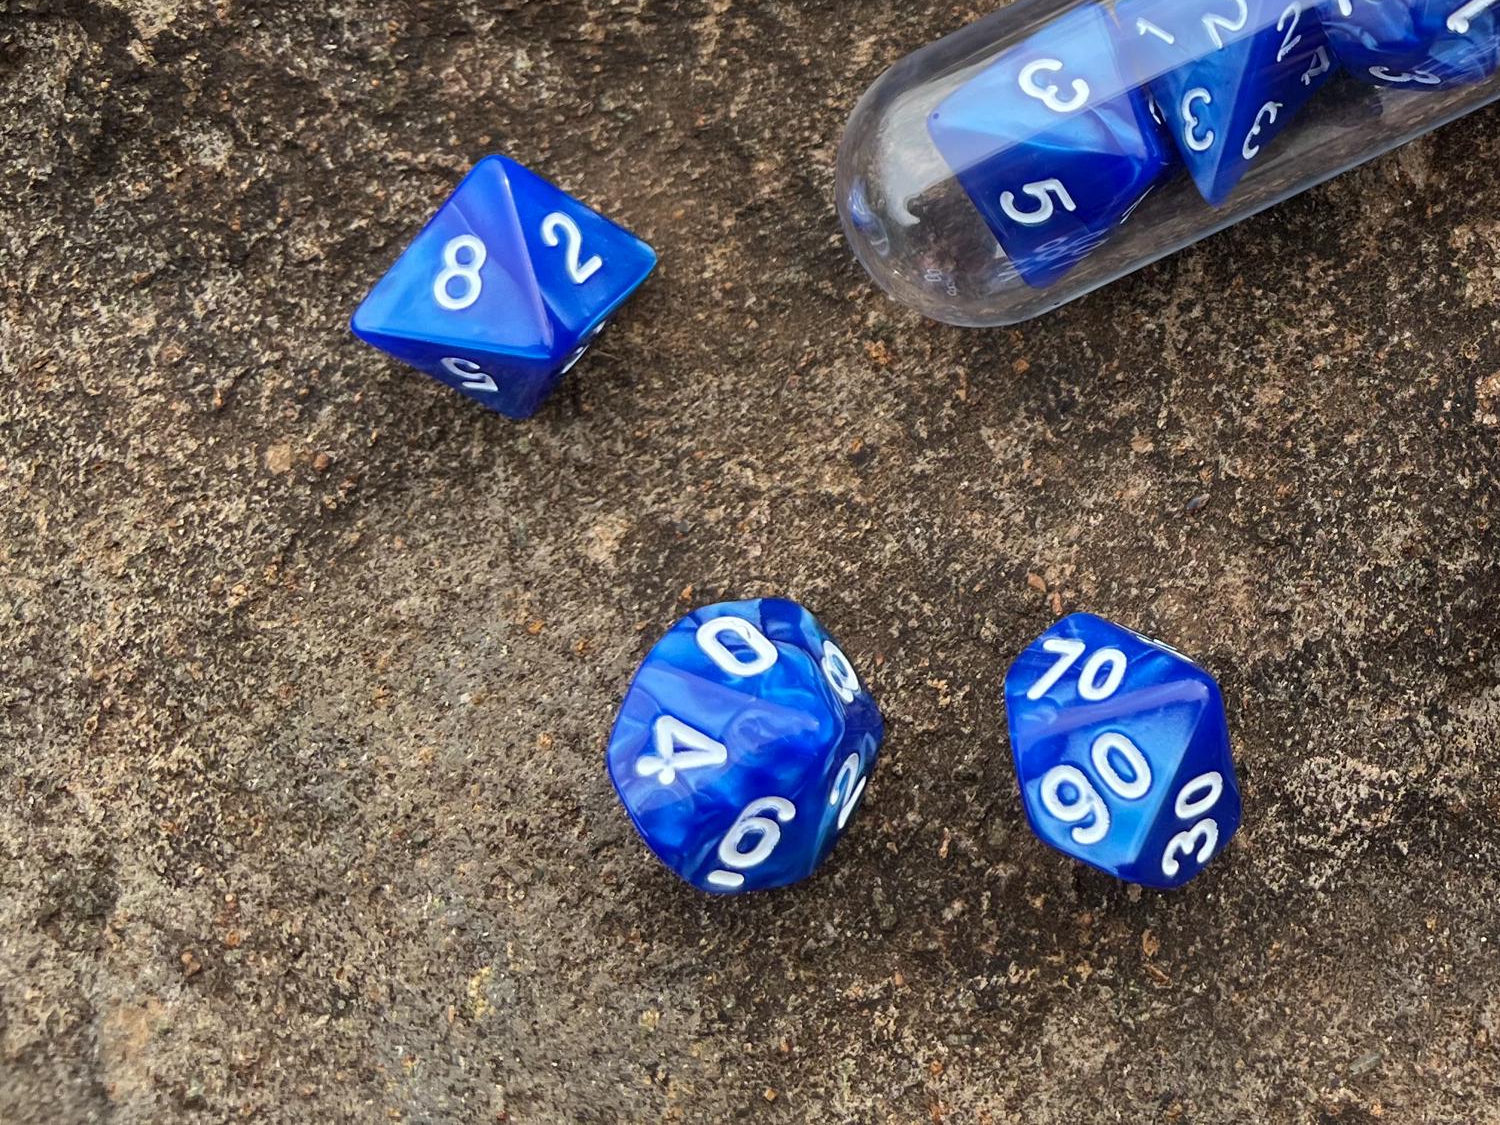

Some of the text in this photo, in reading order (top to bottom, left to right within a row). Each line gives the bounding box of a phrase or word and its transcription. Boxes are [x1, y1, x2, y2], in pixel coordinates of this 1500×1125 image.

[1136, 17, 1175, 46] 1
[1276, 1, 1302, 63] 2
[1018, 58, 1090, 112] 3
[1181, 87, 1214, 151] 3
[1242, 100, 1283, 160] 3
[1000, 178, 1077, 225] 5
[433, 234, 487, 310] 8
[540, 211, 603, 284] 2
[441, 357, 499, 392] 5
[696, 616, 779, 677] 0
[1026, 638, 1127, 701] 70
[635, 714, 728, 786] 4
[1040, 732, 1152, 845] 90
[1162, 771, 1223, 876] 30
